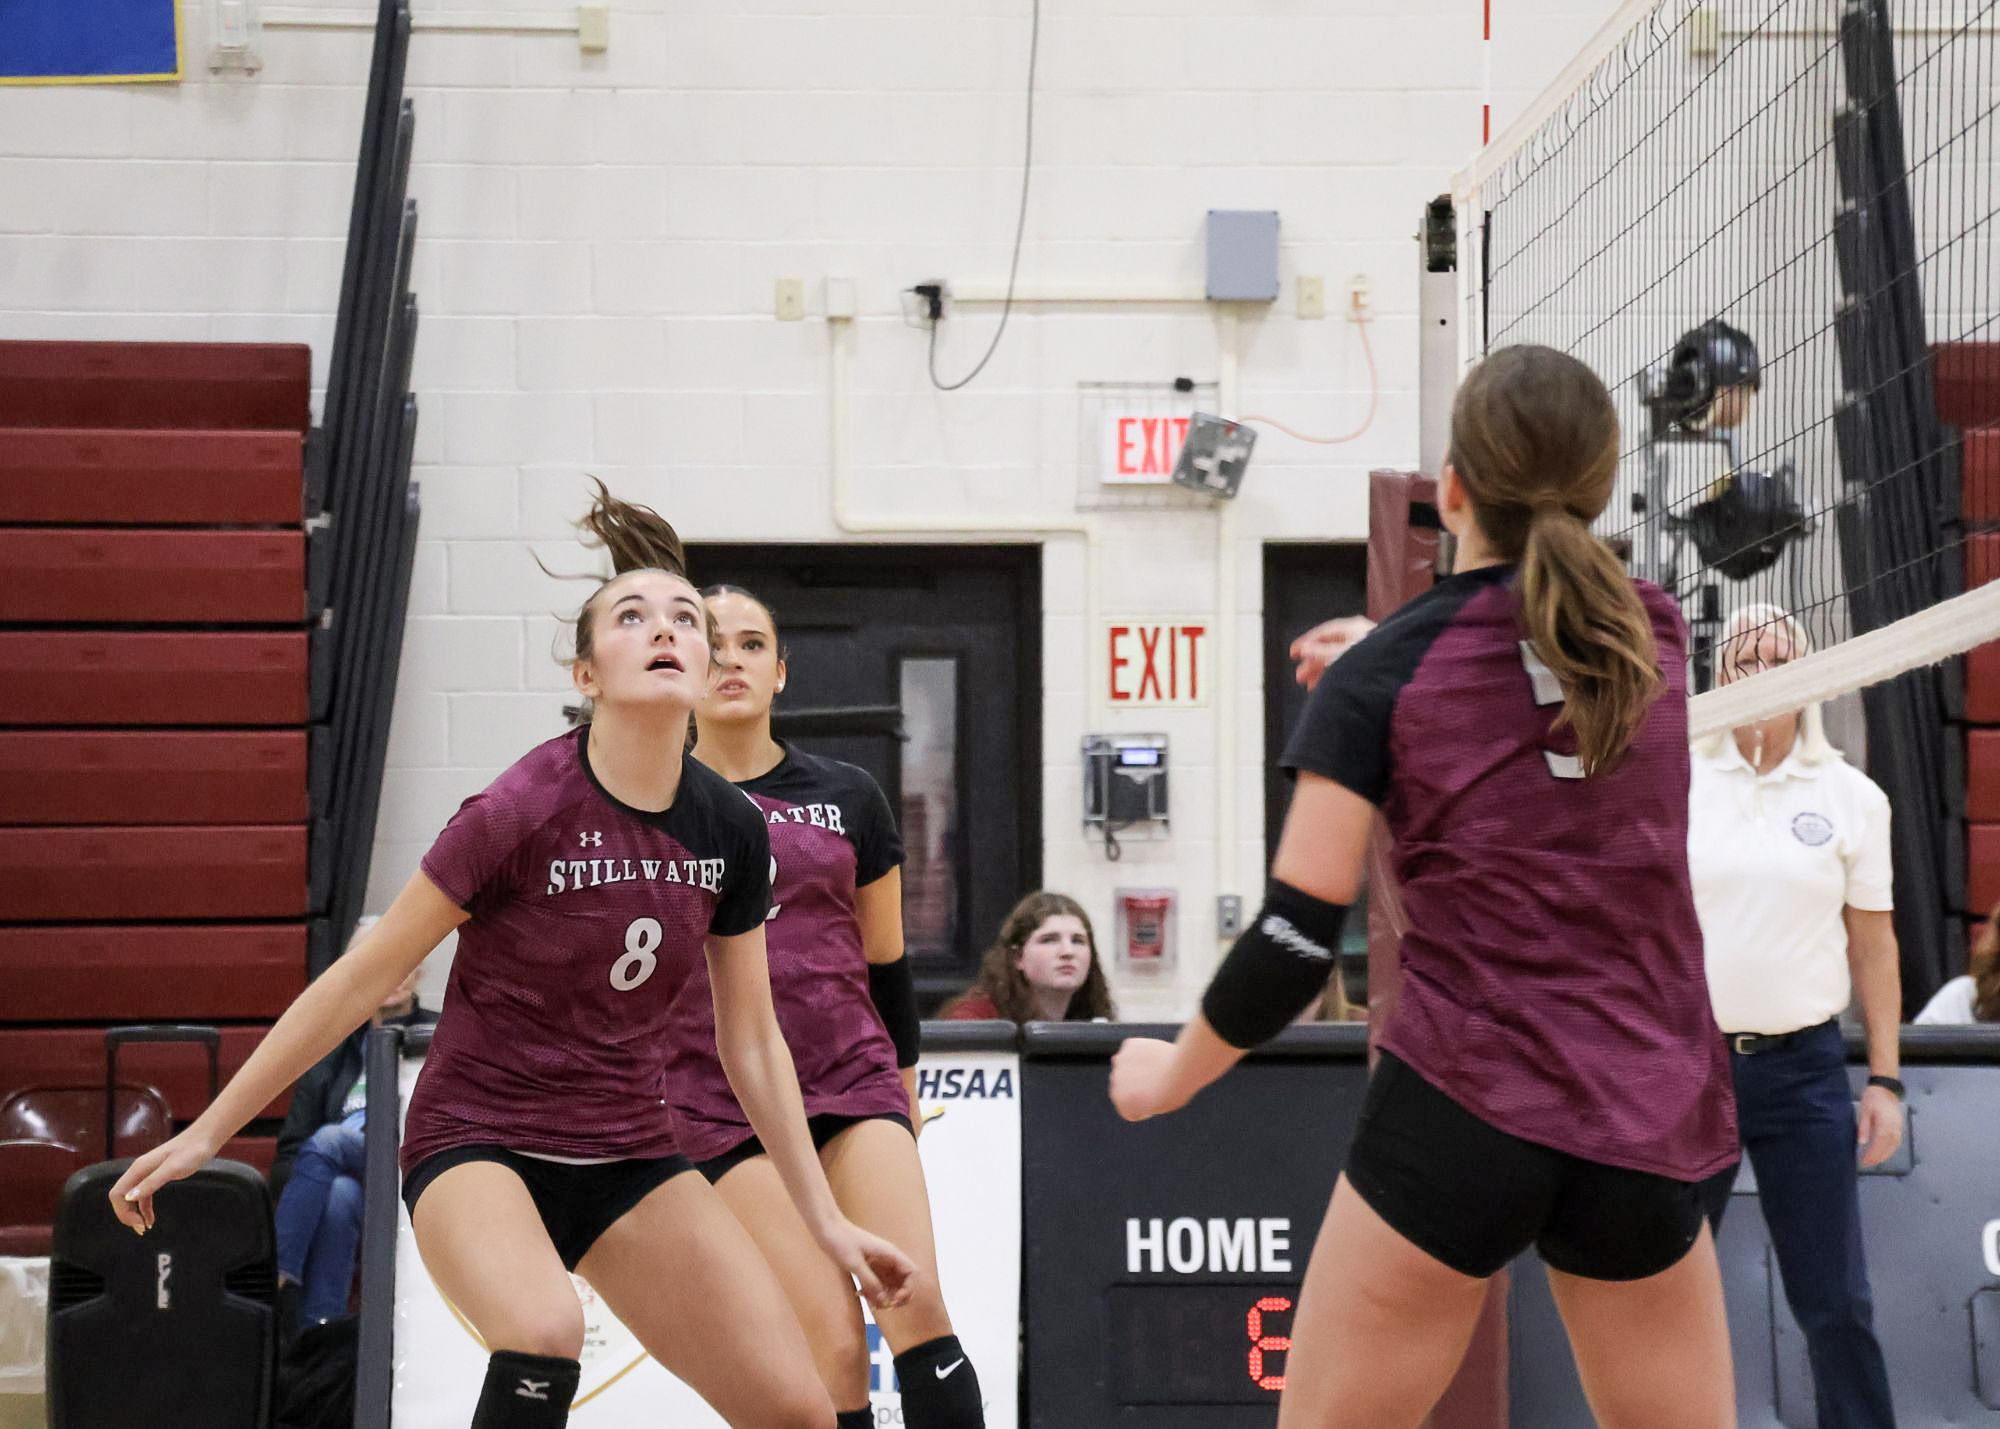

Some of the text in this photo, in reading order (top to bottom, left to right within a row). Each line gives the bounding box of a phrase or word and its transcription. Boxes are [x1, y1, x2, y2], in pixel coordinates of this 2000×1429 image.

[1109, 626, 1205, 701] EXIT
[768, 803, 845, 836] ATER
[547, 858, 725, 896] STILLWATER
[609, 917, 663, 992] 8
[918, 1068, 1014, 1099] HSAA
[1126, 1216, 1292, 1274] HOME
